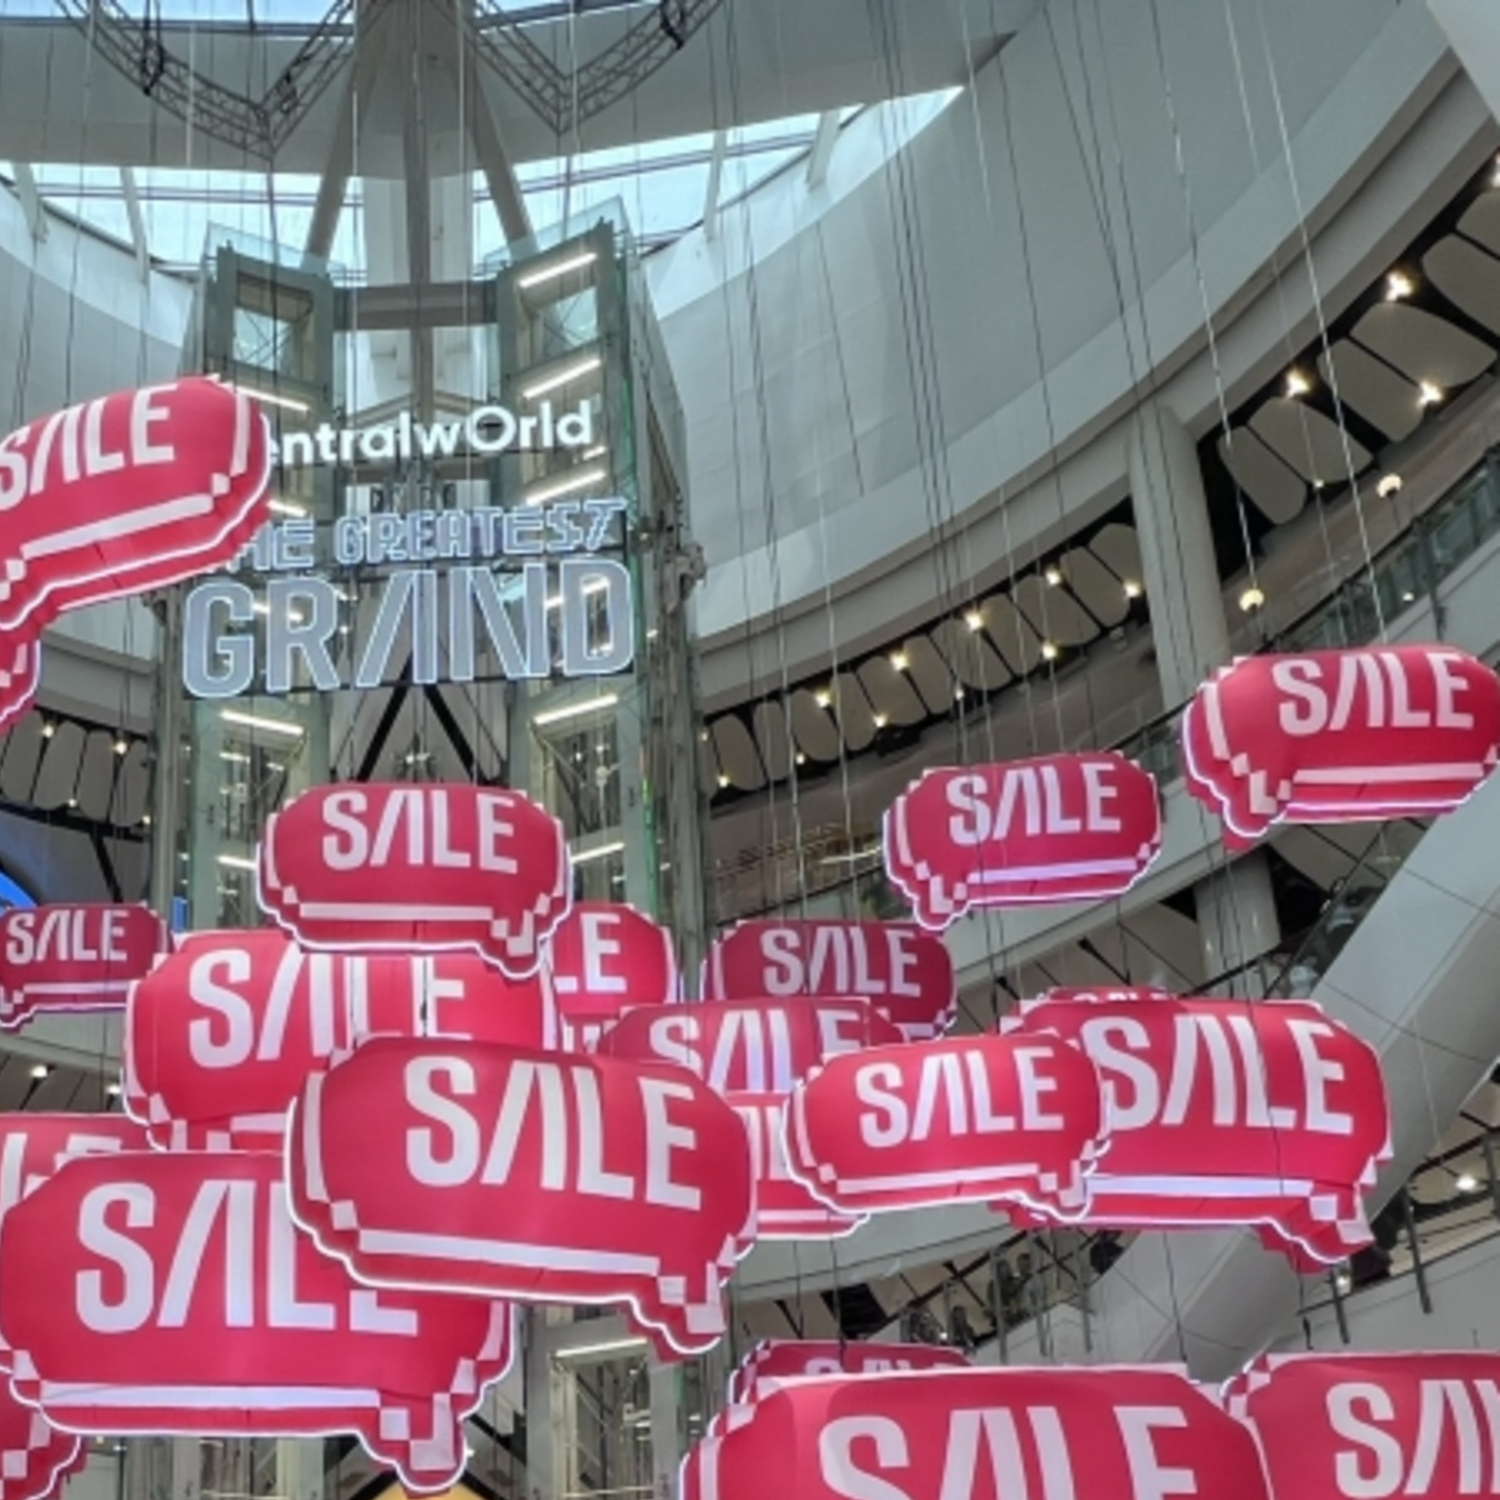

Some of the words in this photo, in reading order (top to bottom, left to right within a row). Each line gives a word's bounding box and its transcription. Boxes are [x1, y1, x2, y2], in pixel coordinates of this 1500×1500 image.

[270, 401, 593, 465] entralwOrld
[226, 514, 315, 574] HE
[334, 498, 629, 565] GREATEST
[182, 558, 636, 698] GRAND
[1271, 652, 1476, 735] SALE
[322, 790, 518, 875] SALE
[945, 762, 1121, 844] SALE
[6, 908, 128, 966] SALE
[760, 926, 922, 997] SALE
[855, 1047, 1065, 1148] SALE
[1080, 1015, 1354, 1135] SALE
[403, 1056, 701, 1211] SALE
